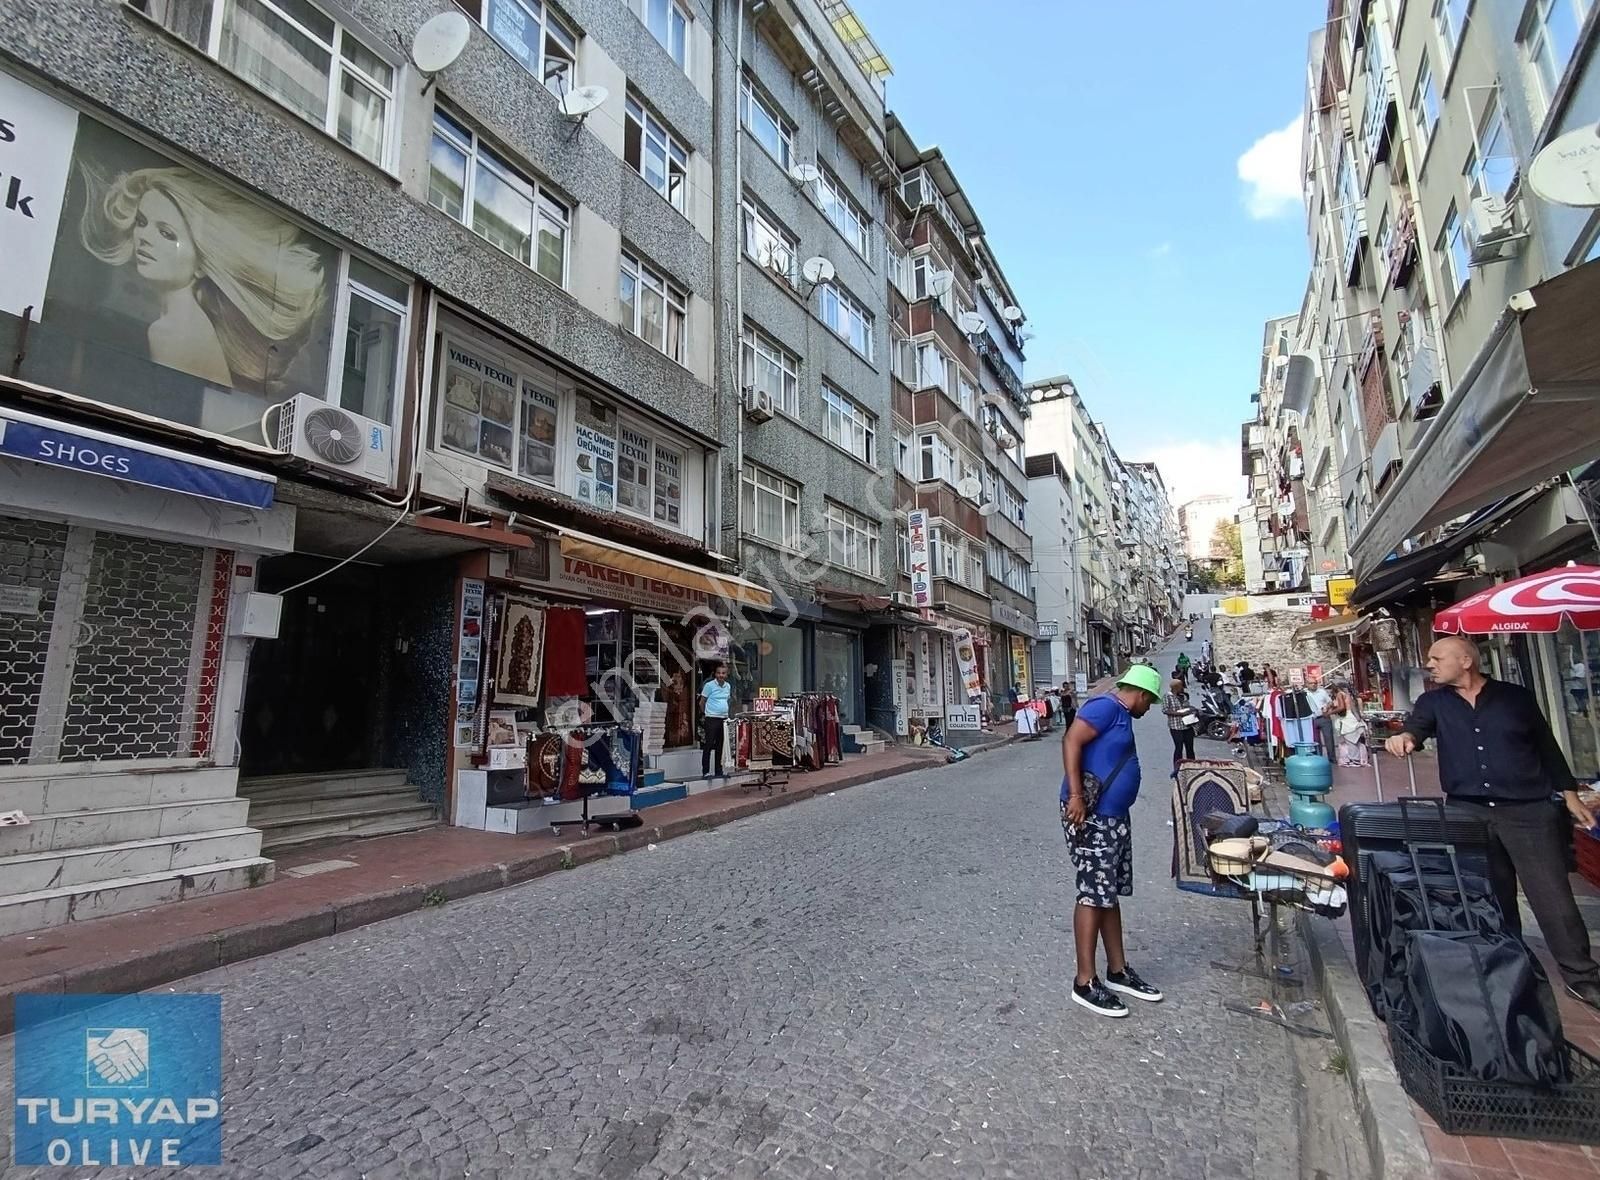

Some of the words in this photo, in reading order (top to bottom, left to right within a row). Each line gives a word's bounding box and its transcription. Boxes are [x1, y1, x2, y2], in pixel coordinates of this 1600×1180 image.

[450, 349, 482, 372] YAREN
[576, 426, 593, 440] HAC
[594, 431, 615, 450] ÜMRE
[622, 429, 649, 450] HAYAT
[39, 440, 130, 473] SHOES
[655, 447, 679, 466] HAYAT
[910, 513, 925, 553] STAR
[912, 562, 927, 604] KIDS
[1491, 622, 1528, 630] ALGIDA
[949, 709, 977, 723] mia
